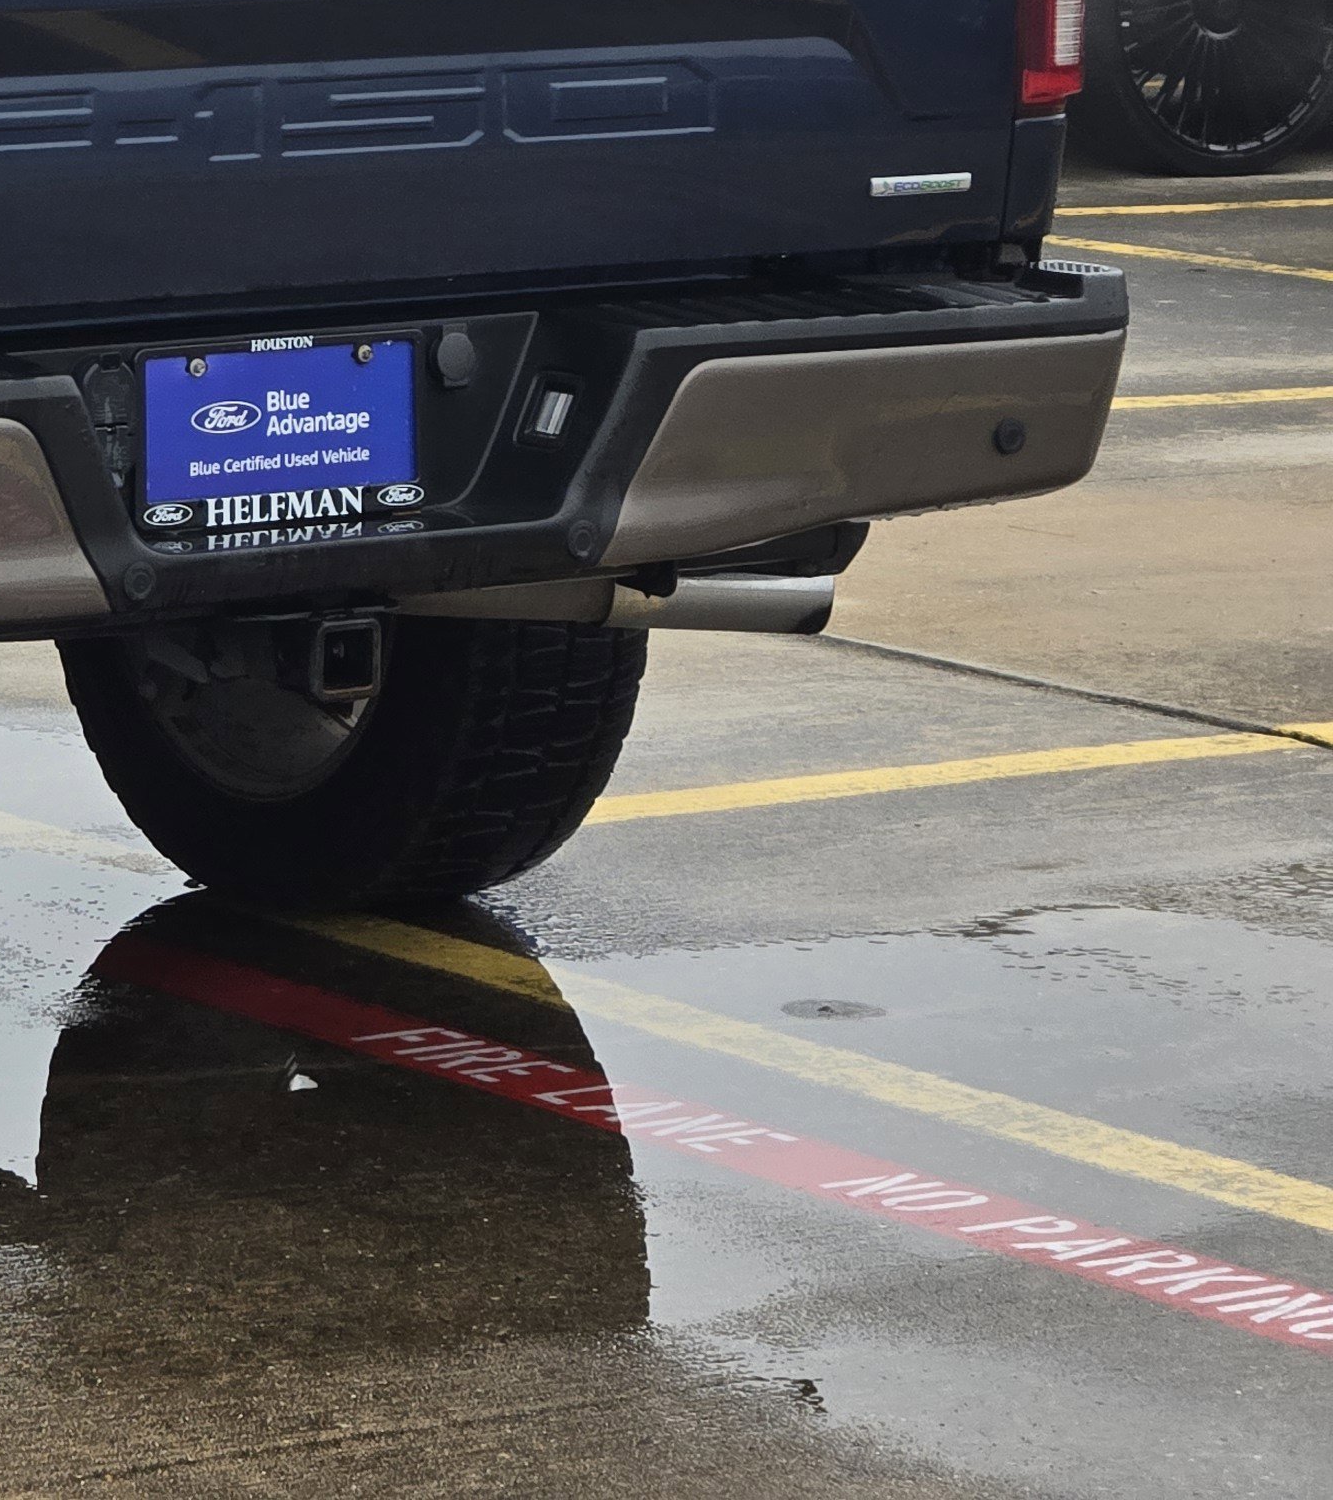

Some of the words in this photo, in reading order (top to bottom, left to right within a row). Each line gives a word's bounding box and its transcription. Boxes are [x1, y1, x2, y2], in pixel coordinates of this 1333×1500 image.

[250, 335, 314, 352] HOUSTON
[266, 390, 310, 412] Blue
[204, 406, 247, 429] Ford
[266, 410, 370, 437] Advantage
[189, 462, 220, 477] Blue
[224, 452, 281, 472] Certified
[284, 453, 319, 468] Used
[322, 446, 370, 464] Vehicle
[205, 486, 364, 527] HELFMAN
[385, 486, 417, 504] Ford
[152, 506, 184, 524] Ford
[351, 1026, 576, 1083] FIRE
[532, 1084, 800, 1153] LANE
[819, 1172, 989, 1211] NO
